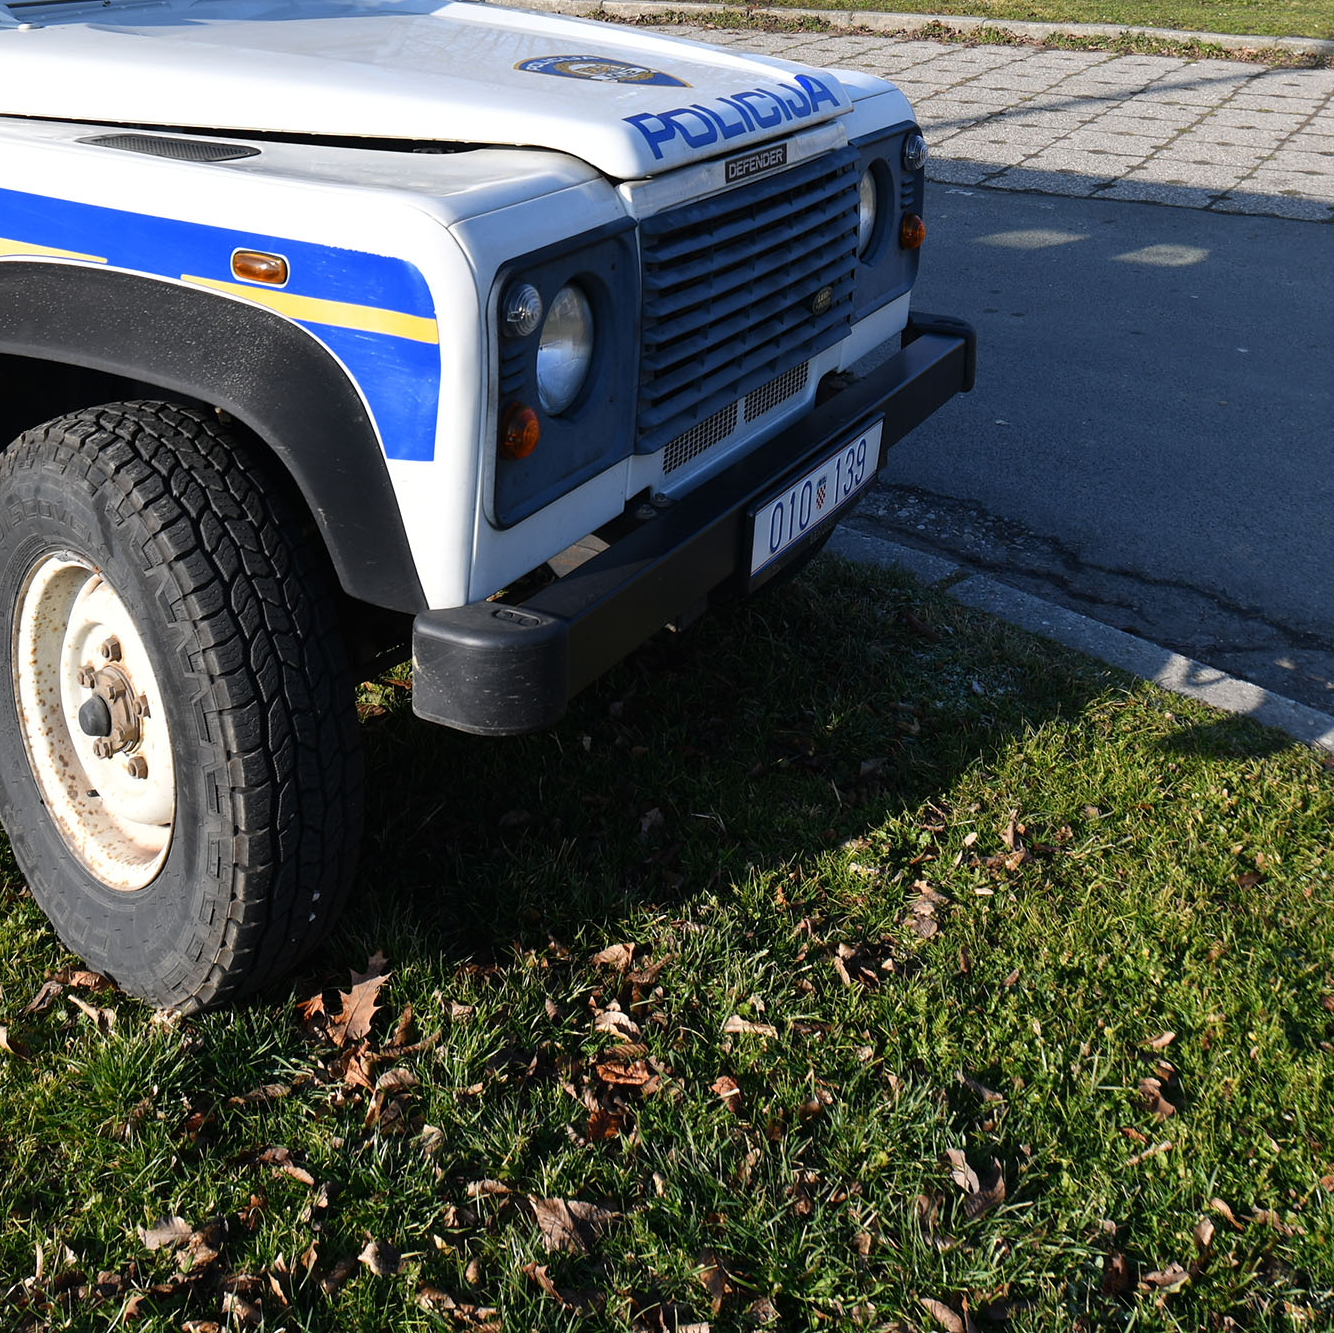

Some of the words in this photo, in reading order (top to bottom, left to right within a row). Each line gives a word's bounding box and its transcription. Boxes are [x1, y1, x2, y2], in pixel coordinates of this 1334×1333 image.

[622, 74, 840, 160] POLICIJA
[728, 147, 784, 179] DEFENDER
[769, 480, 813, 554] 010
[833, 438, 867, 505] 139
